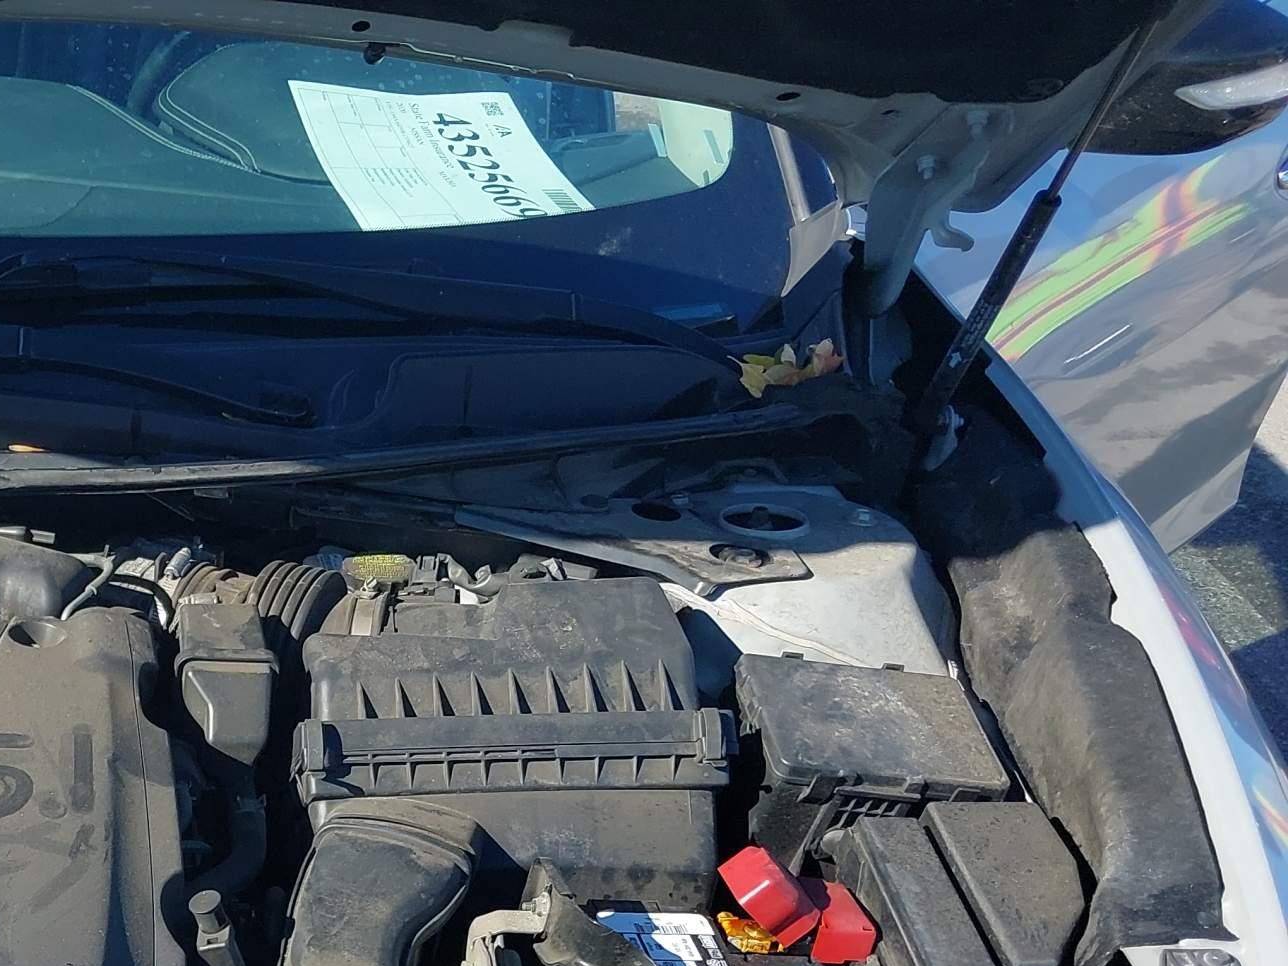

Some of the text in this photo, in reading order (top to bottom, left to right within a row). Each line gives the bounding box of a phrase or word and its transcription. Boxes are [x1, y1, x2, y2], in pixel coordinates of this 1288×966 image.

[408, 102, 455, 169] State Farm Insurance
[432, 112, 549, 217] 43525669
